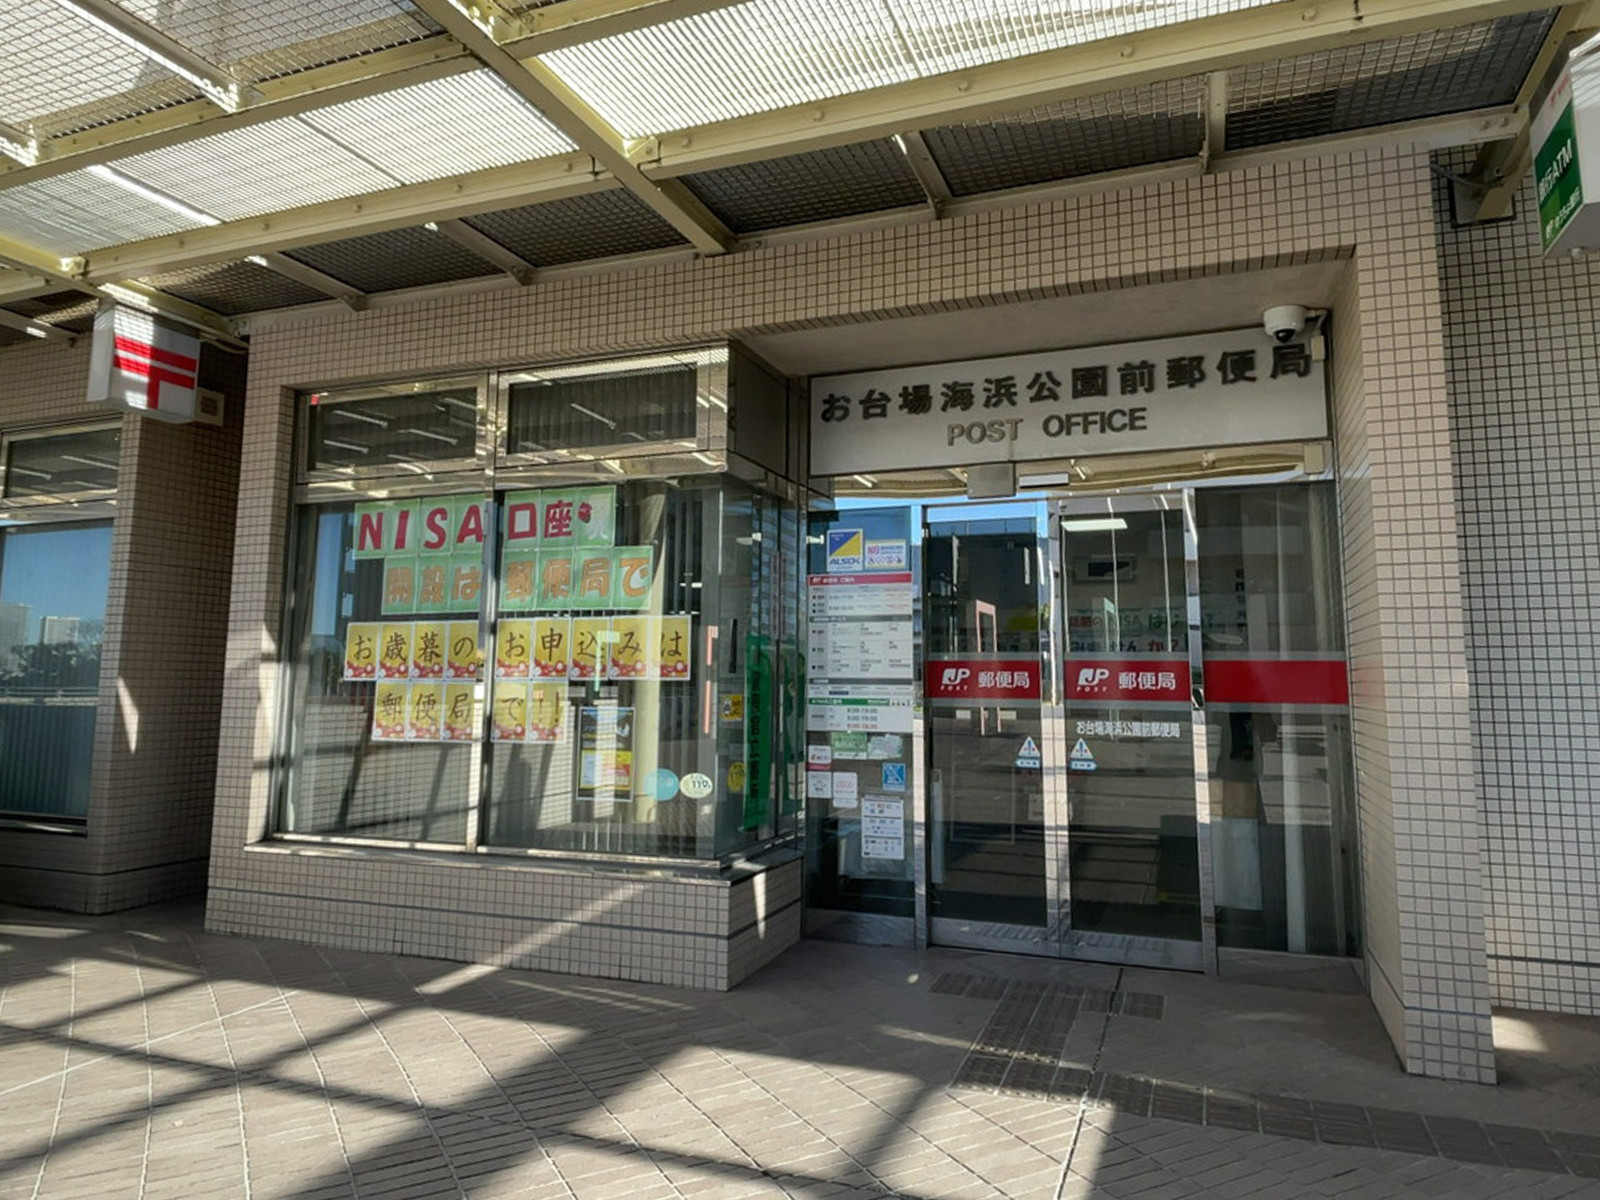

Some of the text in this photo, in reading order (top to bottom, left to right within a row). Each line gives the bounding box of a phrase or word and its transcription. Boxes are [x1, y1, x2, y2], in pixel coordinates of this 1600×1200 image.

[820, 342, 1313, 423] お台場海浜公園前郵便局
[947, 407, 1149, 447] POST OFFICE
[829, 556, 861, 566] ALSOK
[354, 623, 682, 662] お歳暮のお申込みは
[977, 670, 1031, 690] 郵便局
[1118, 671, 1177, 691] 郵便局
